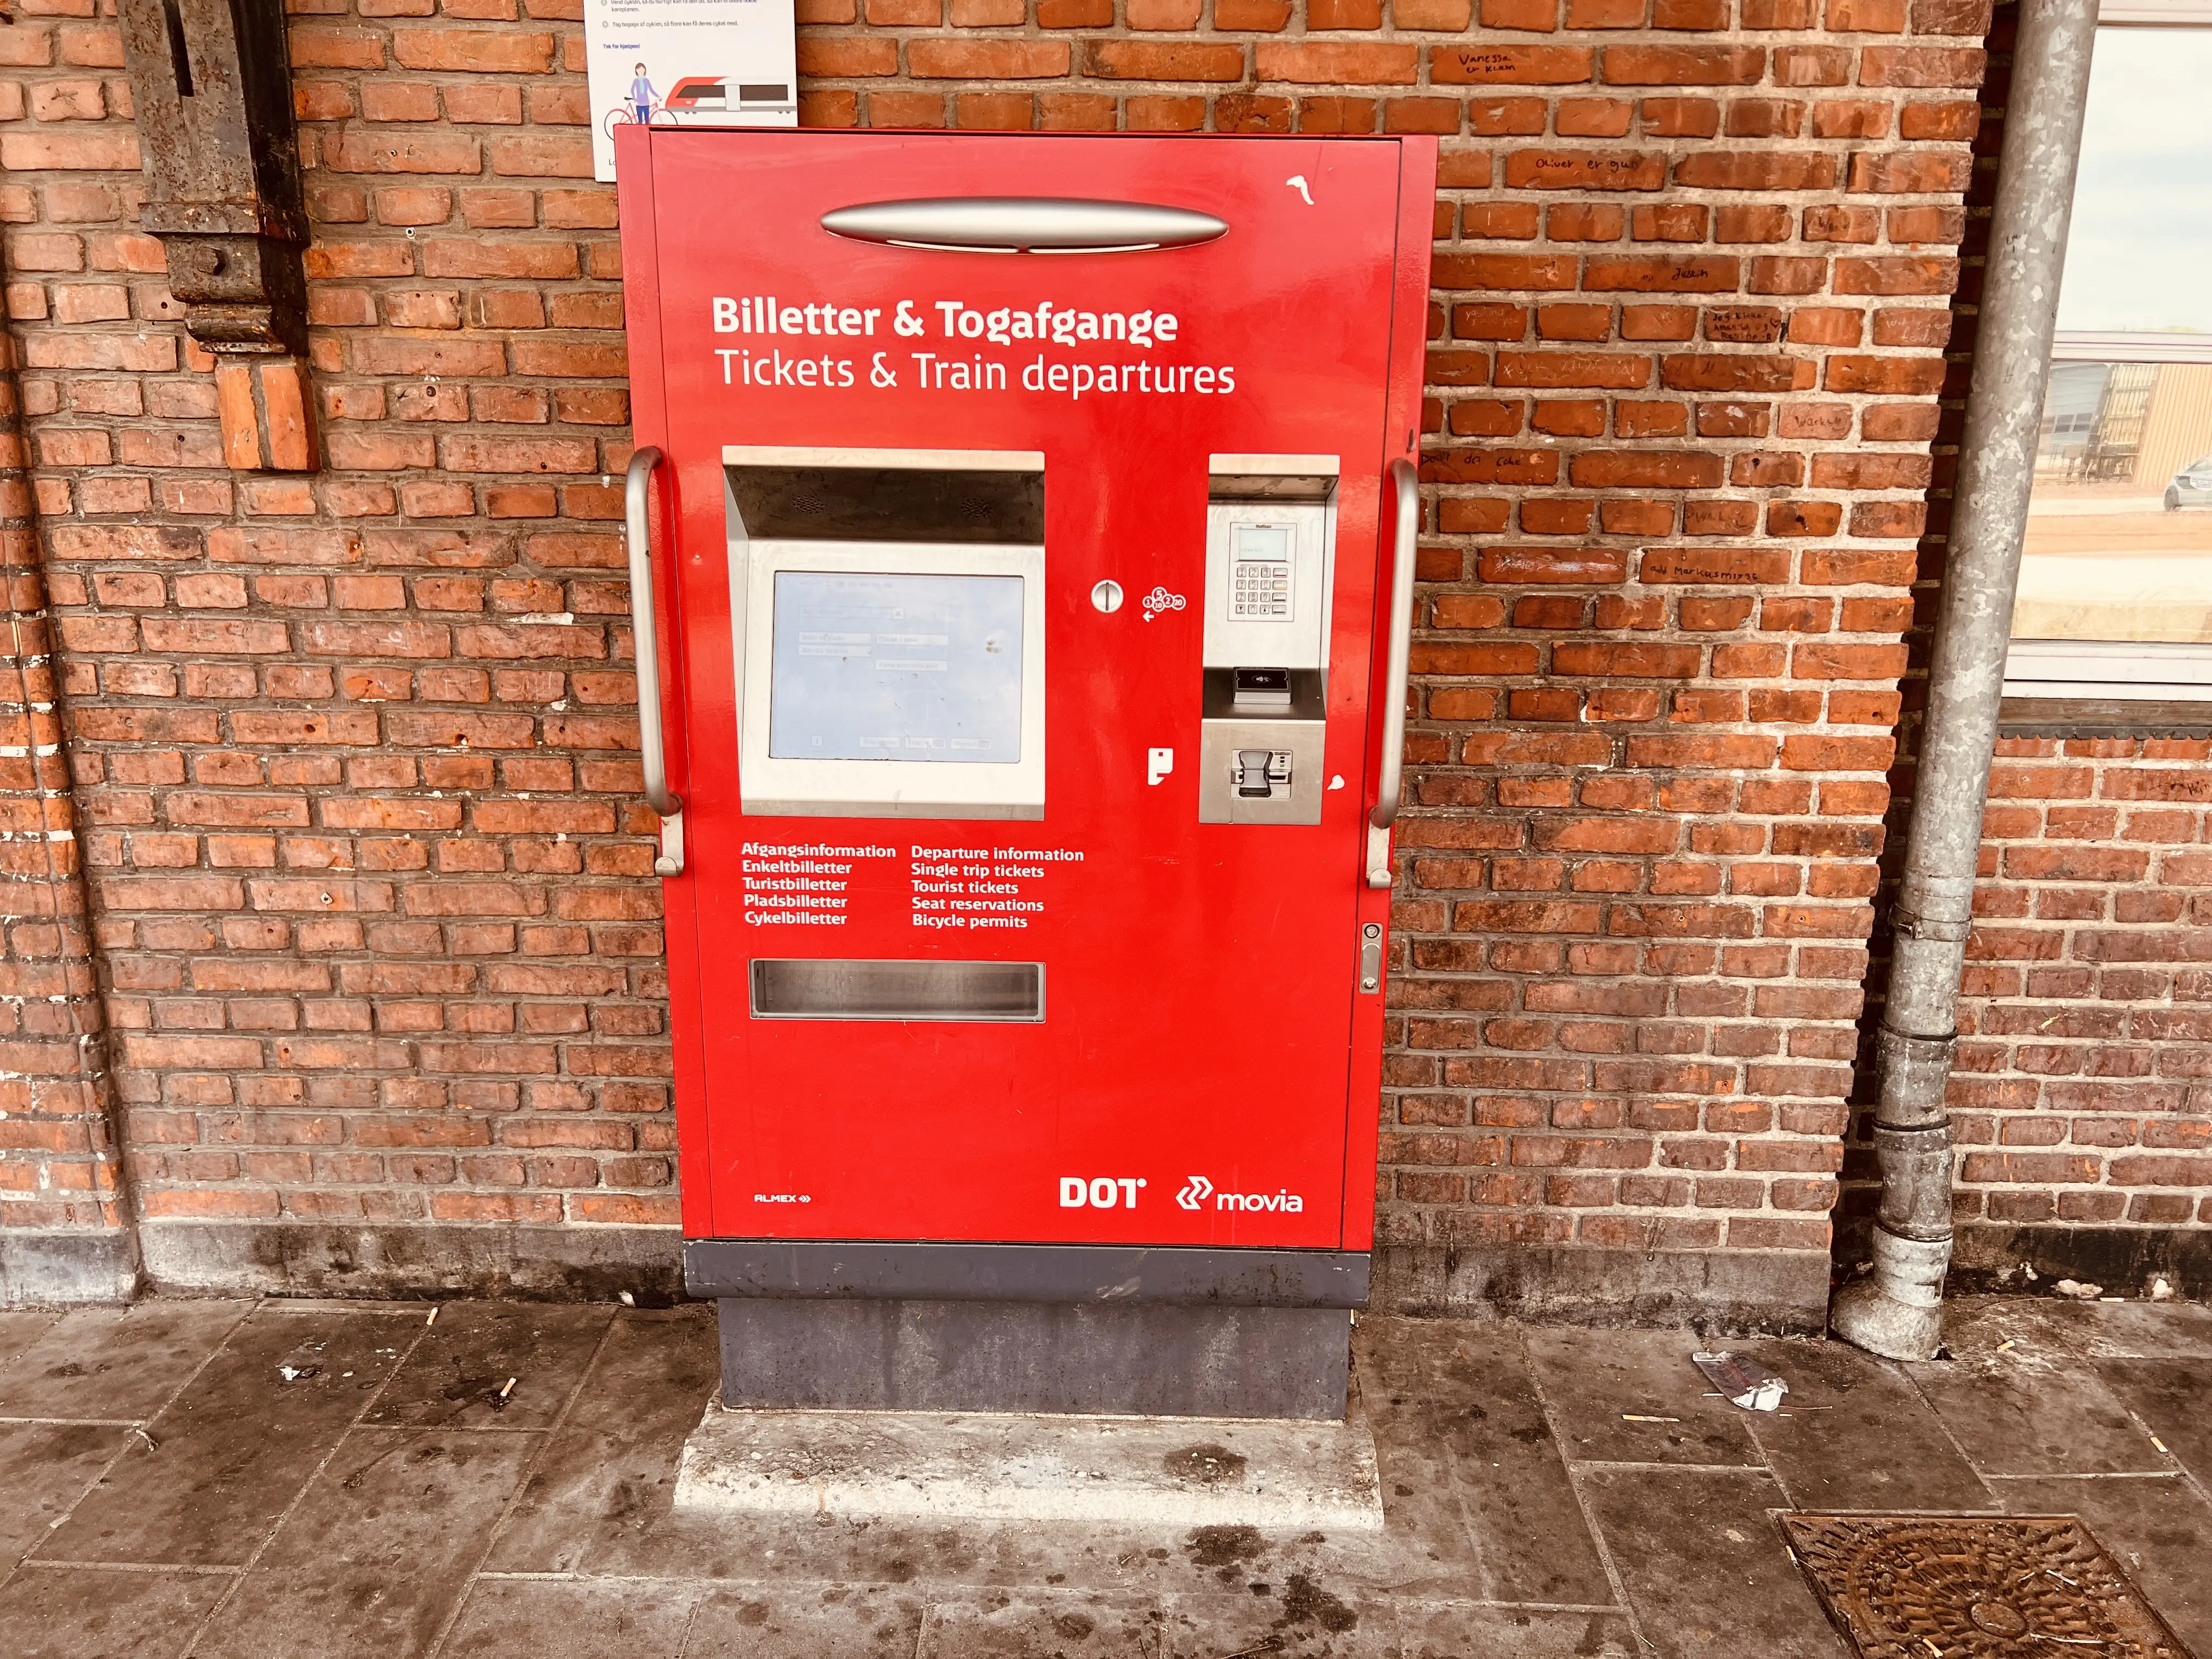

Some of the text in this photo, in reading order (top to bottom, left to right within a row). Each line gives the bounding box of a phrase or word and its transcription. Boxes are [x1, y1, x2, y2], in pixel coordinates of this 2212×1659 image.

[1458, 54, 1511, 66] Vanessa
[1587, 160, 1603, 170] er
[712, 296, 1178, 348] Billetter & Togafgange
[714, 348, 1235, 400] Tickets & Train departures
[1156, 590, 1163, 600] 5
[741, 842, 896, 858] Afgangsinformation
[911, 845, 1084, 861] Departure information
[742, 859, 852, 874] Enkeltbilletter
[911, 862, 1045, 879] Single trip tickets
[742, 877, 848, 891] Turistbilletter
[911, 879, 1019, 894] Tourist tickets
[744, 894, 848, 908] Pladsbilletter
[912, 896, 1044, 911] Seat reservations
[744, 911, 848, 927] Cykelbilletter
[912, 914, 1028, 929] Bicycle permits
[754, 1194, 797, 1203] ALMEX
[1060, 1177, 1138, 1208] DOT
[1217, 1189, 1303, 1212] movia
